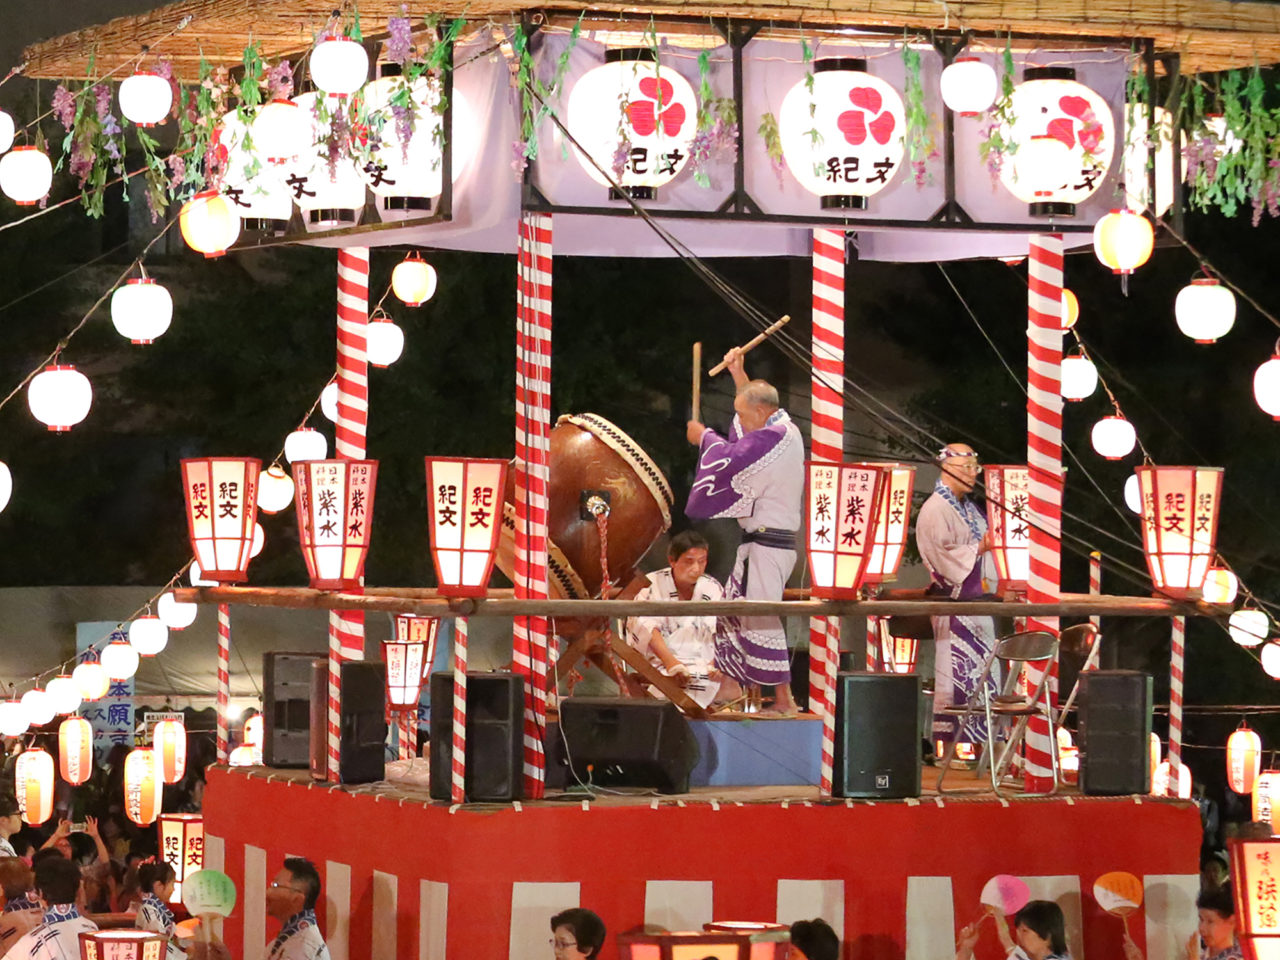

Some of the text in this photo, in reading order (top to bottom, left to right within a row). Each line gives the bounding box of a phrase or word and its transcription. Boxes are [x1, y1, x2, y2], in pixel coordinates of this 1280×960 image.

[286, 173, 317, 200] 文
[825, 156, 895, 185] 紀文
[192, 482, 209, 520] 紀文
[218, 482, 238, 519] 紀文
[318, 489, 338, 539] 紫水
[437, 484, 458, 527] 紀文
[469, 486, 493, 528] 紀文
[1163, 492, 1187, 533] 紀文
[840, 495, 866, 548] 紫水
[165, 836, 179, 866] 紀文
[187, 836, 204, 866] 紀文
